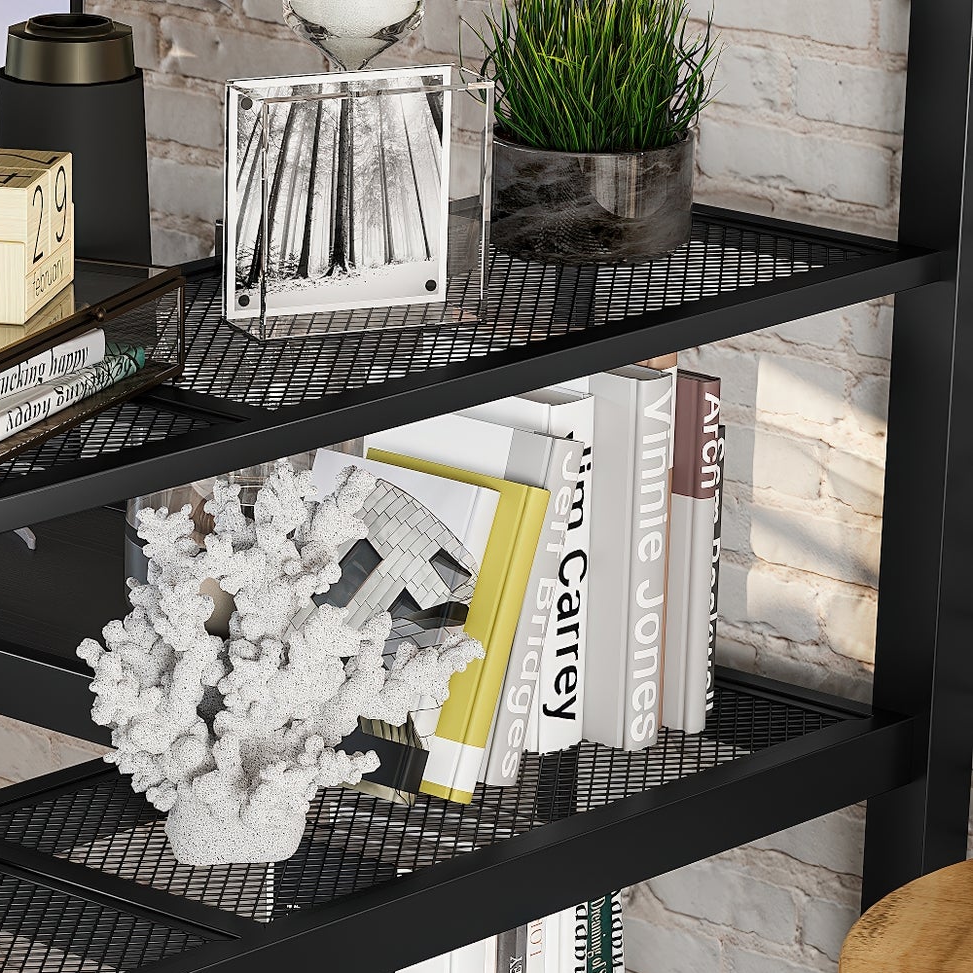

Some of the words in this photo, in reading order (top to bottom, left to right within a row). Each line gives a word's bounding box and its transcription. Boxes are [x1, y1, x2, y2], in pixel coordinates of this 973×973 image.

[49, 347, 89, 378] happy
[638, 388, 671, 563] Vinnie
[702, 391, 721, 488] Arch
[543, 550, 587, 721] Carrey
[629, 581, 664, 742] Jones
[588, 896, 607, 956] Dreaming
